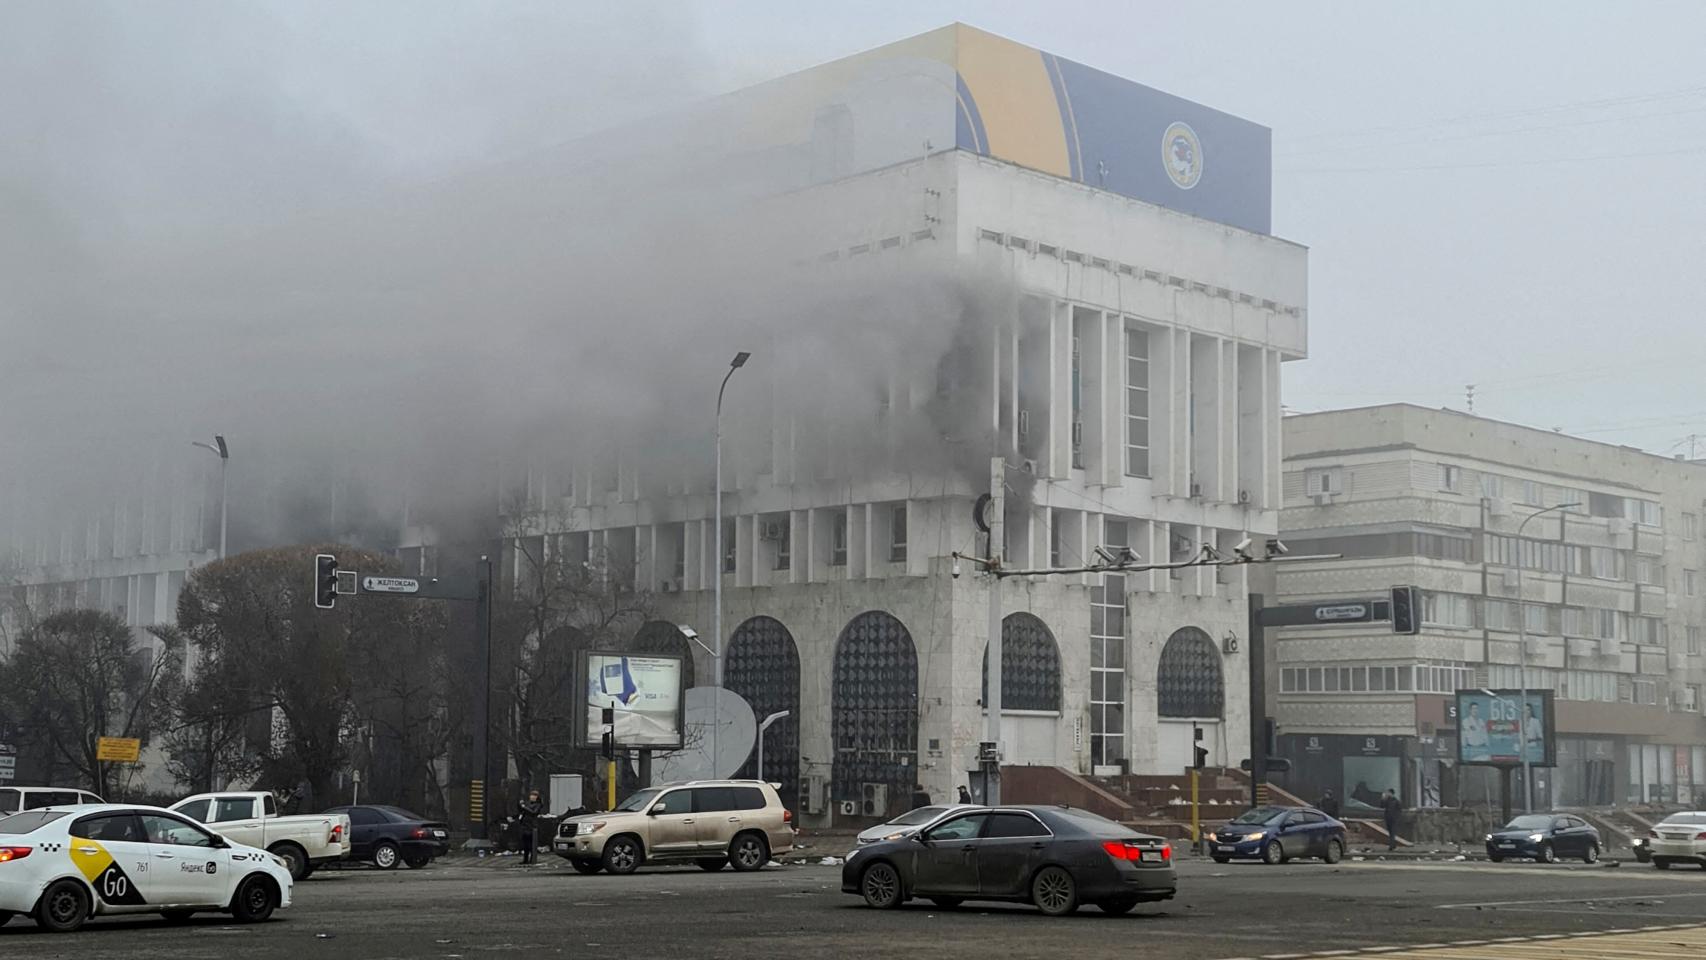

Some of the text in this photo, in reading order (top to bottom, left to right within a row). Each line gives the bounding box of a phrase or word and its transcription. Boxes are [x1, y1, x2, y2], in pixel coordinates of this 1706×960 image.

[136, 862, 148, 872] 761
[181, 862, 204, 872] Яндекс
[104, 868, 126, 896] Go
